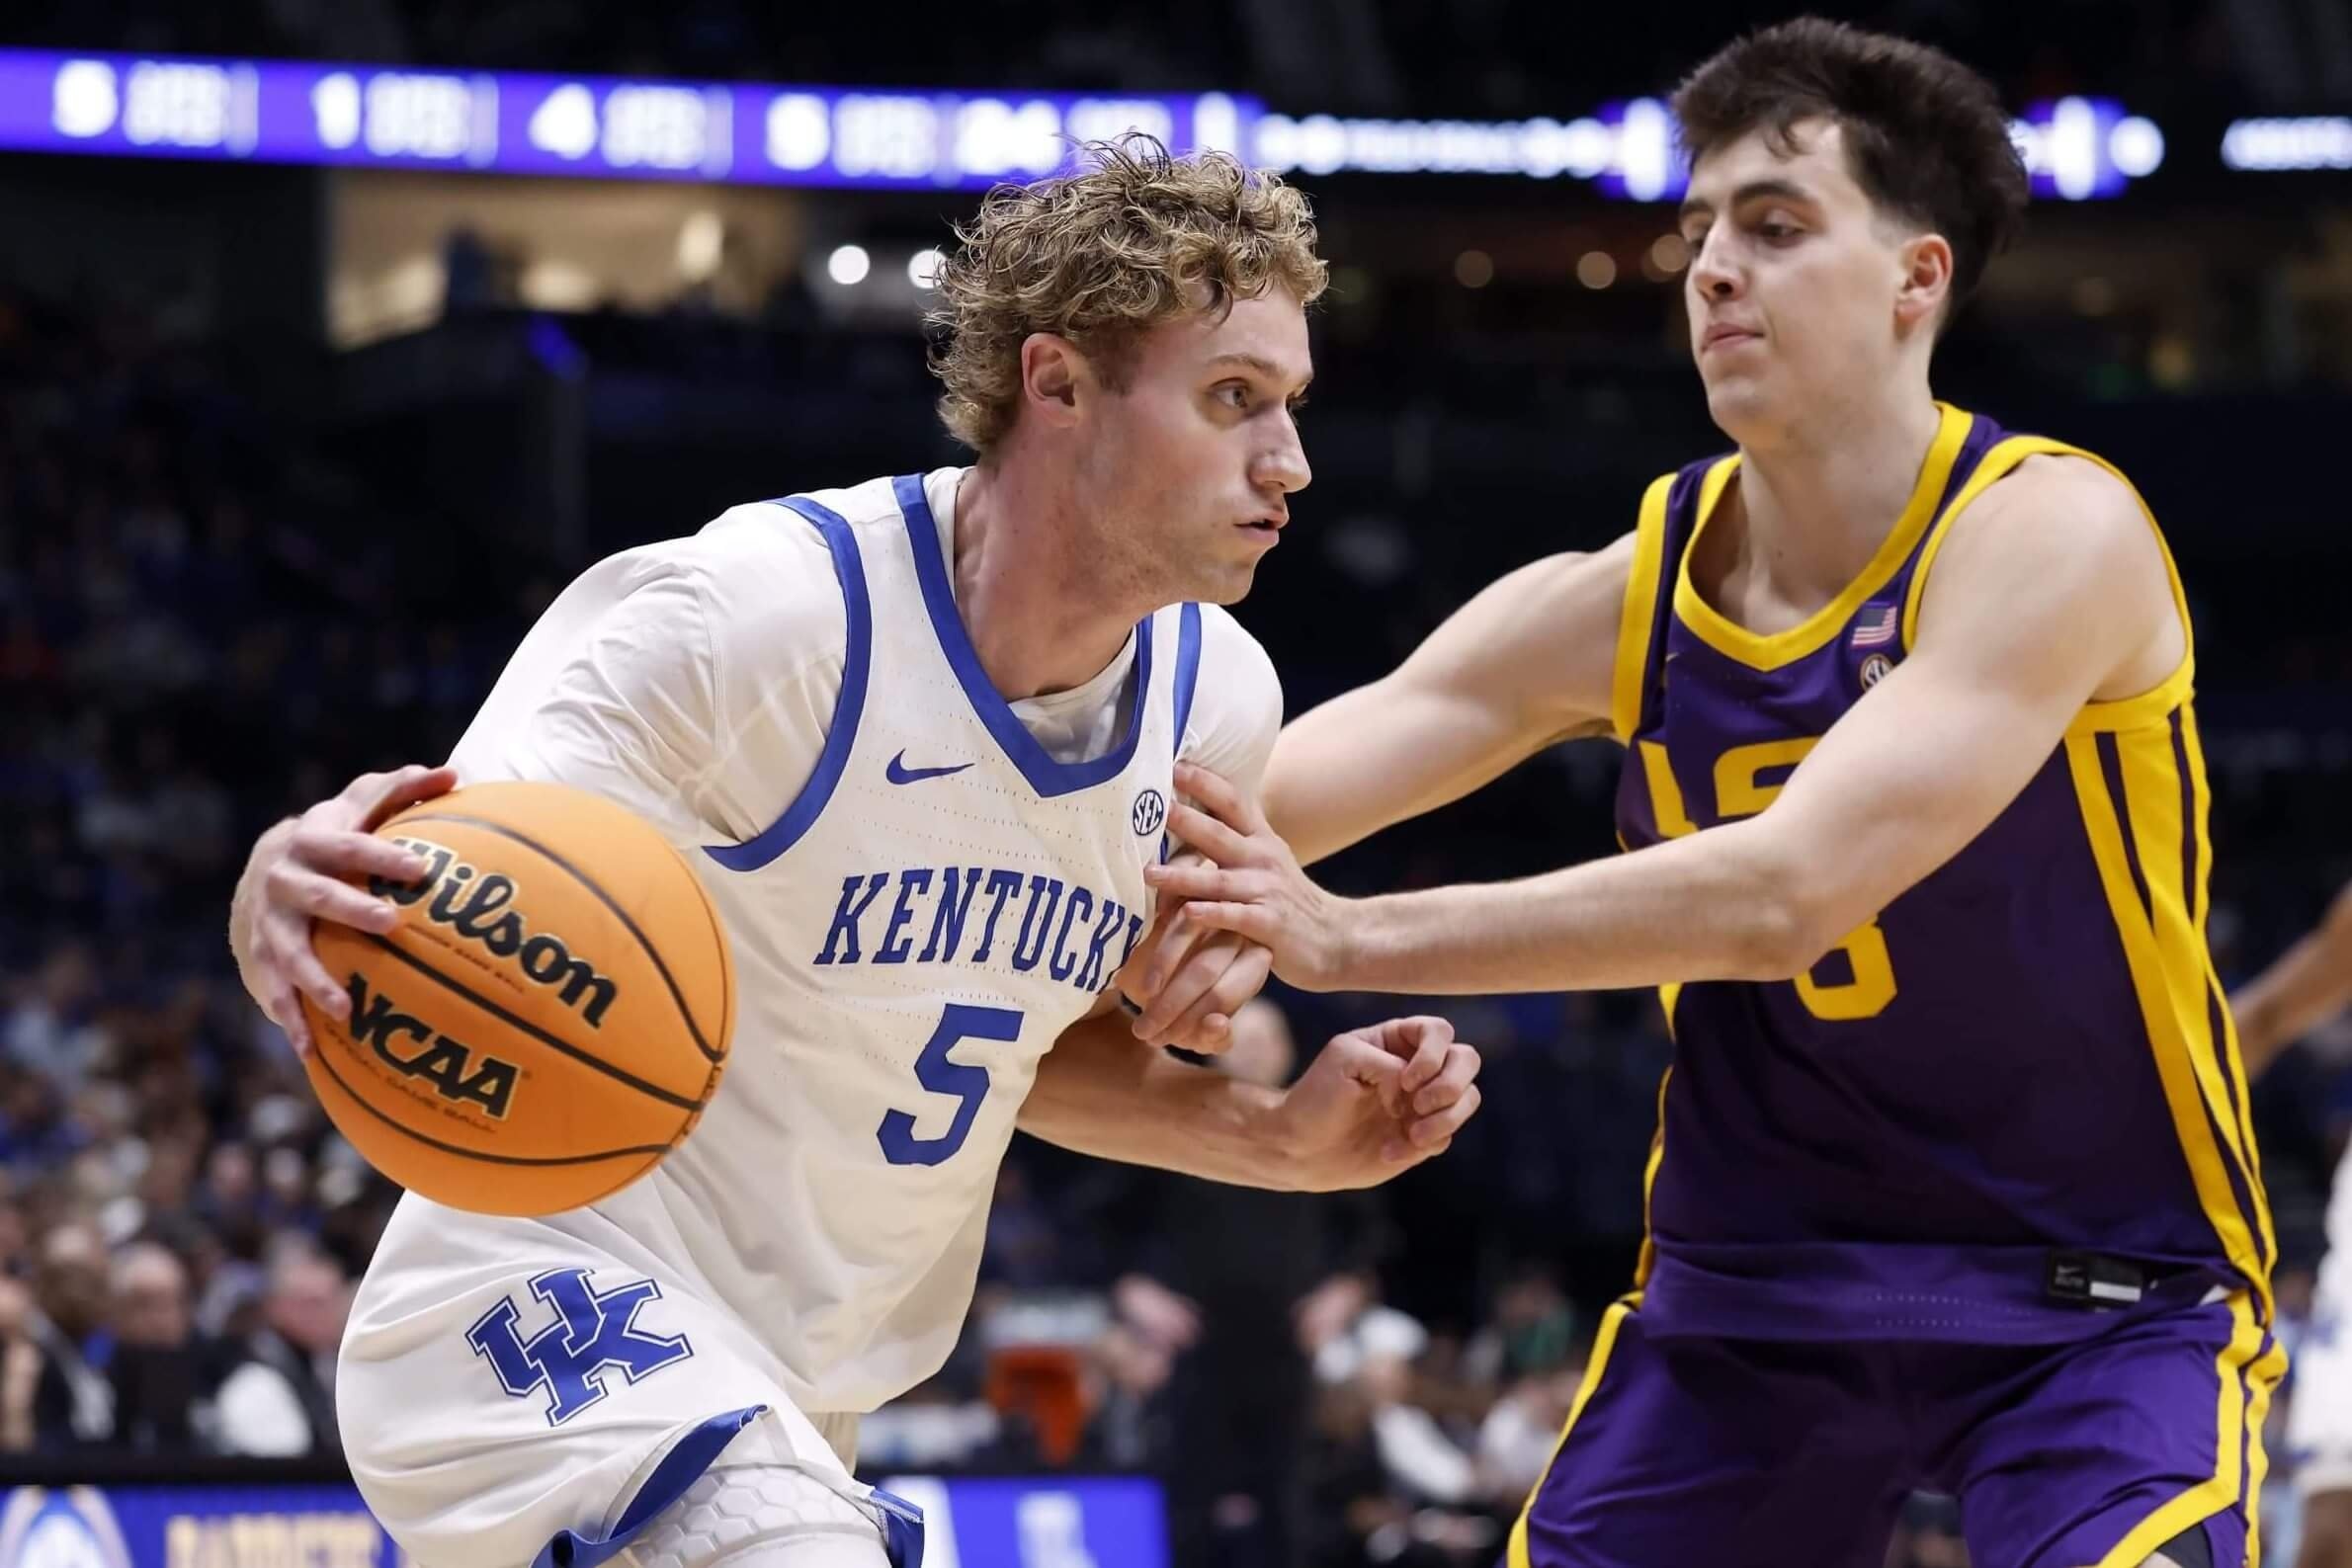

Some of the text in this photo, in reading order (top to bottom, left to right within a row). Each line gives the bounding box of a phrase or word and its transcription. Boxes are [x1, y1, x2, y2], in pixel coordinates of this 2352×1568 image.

[1134, 791, 1162, 834] SEC
[348, 972, 518, 1117] NCAA
[877, 1003, 1024, 1166] 5
[465, 1268, 694, 1427] UK
